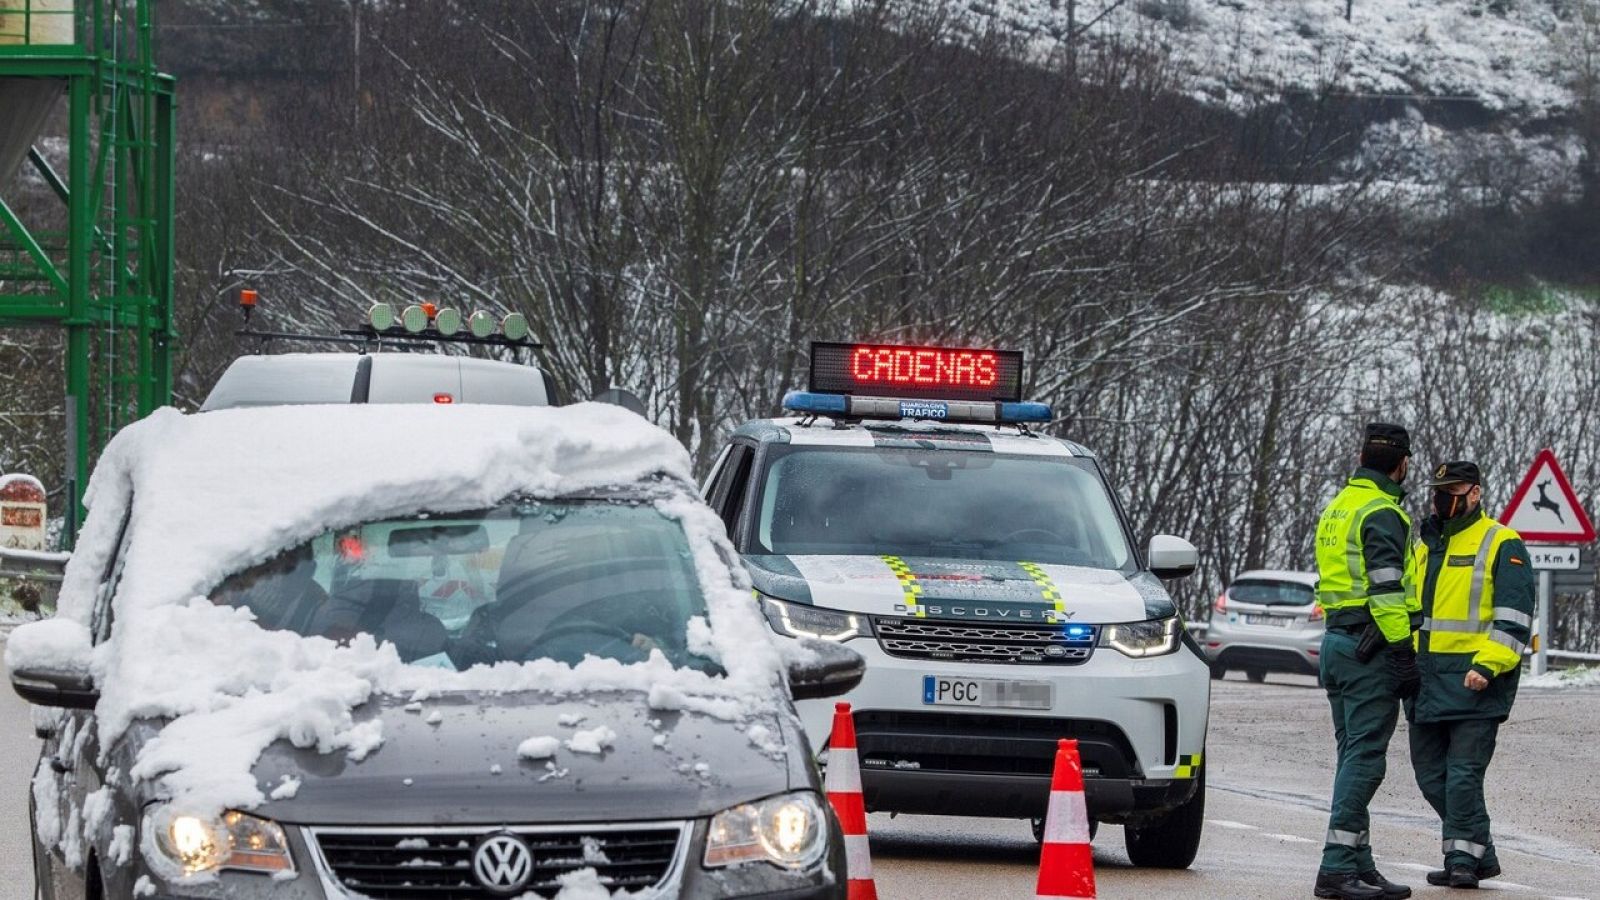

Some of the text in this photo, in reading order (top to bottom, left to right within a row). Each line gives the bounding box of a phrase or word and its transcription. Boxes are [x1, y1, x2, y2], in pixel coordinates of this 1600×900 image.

[853, 348, 997, 386] CADENAS
[901, 408, 946, 418] TRAFICO
[1544, 553, 1563, 563] Km
[894, 603, 1076, 620] DISCOVERY
[938, 680, 979, 702] PGC
